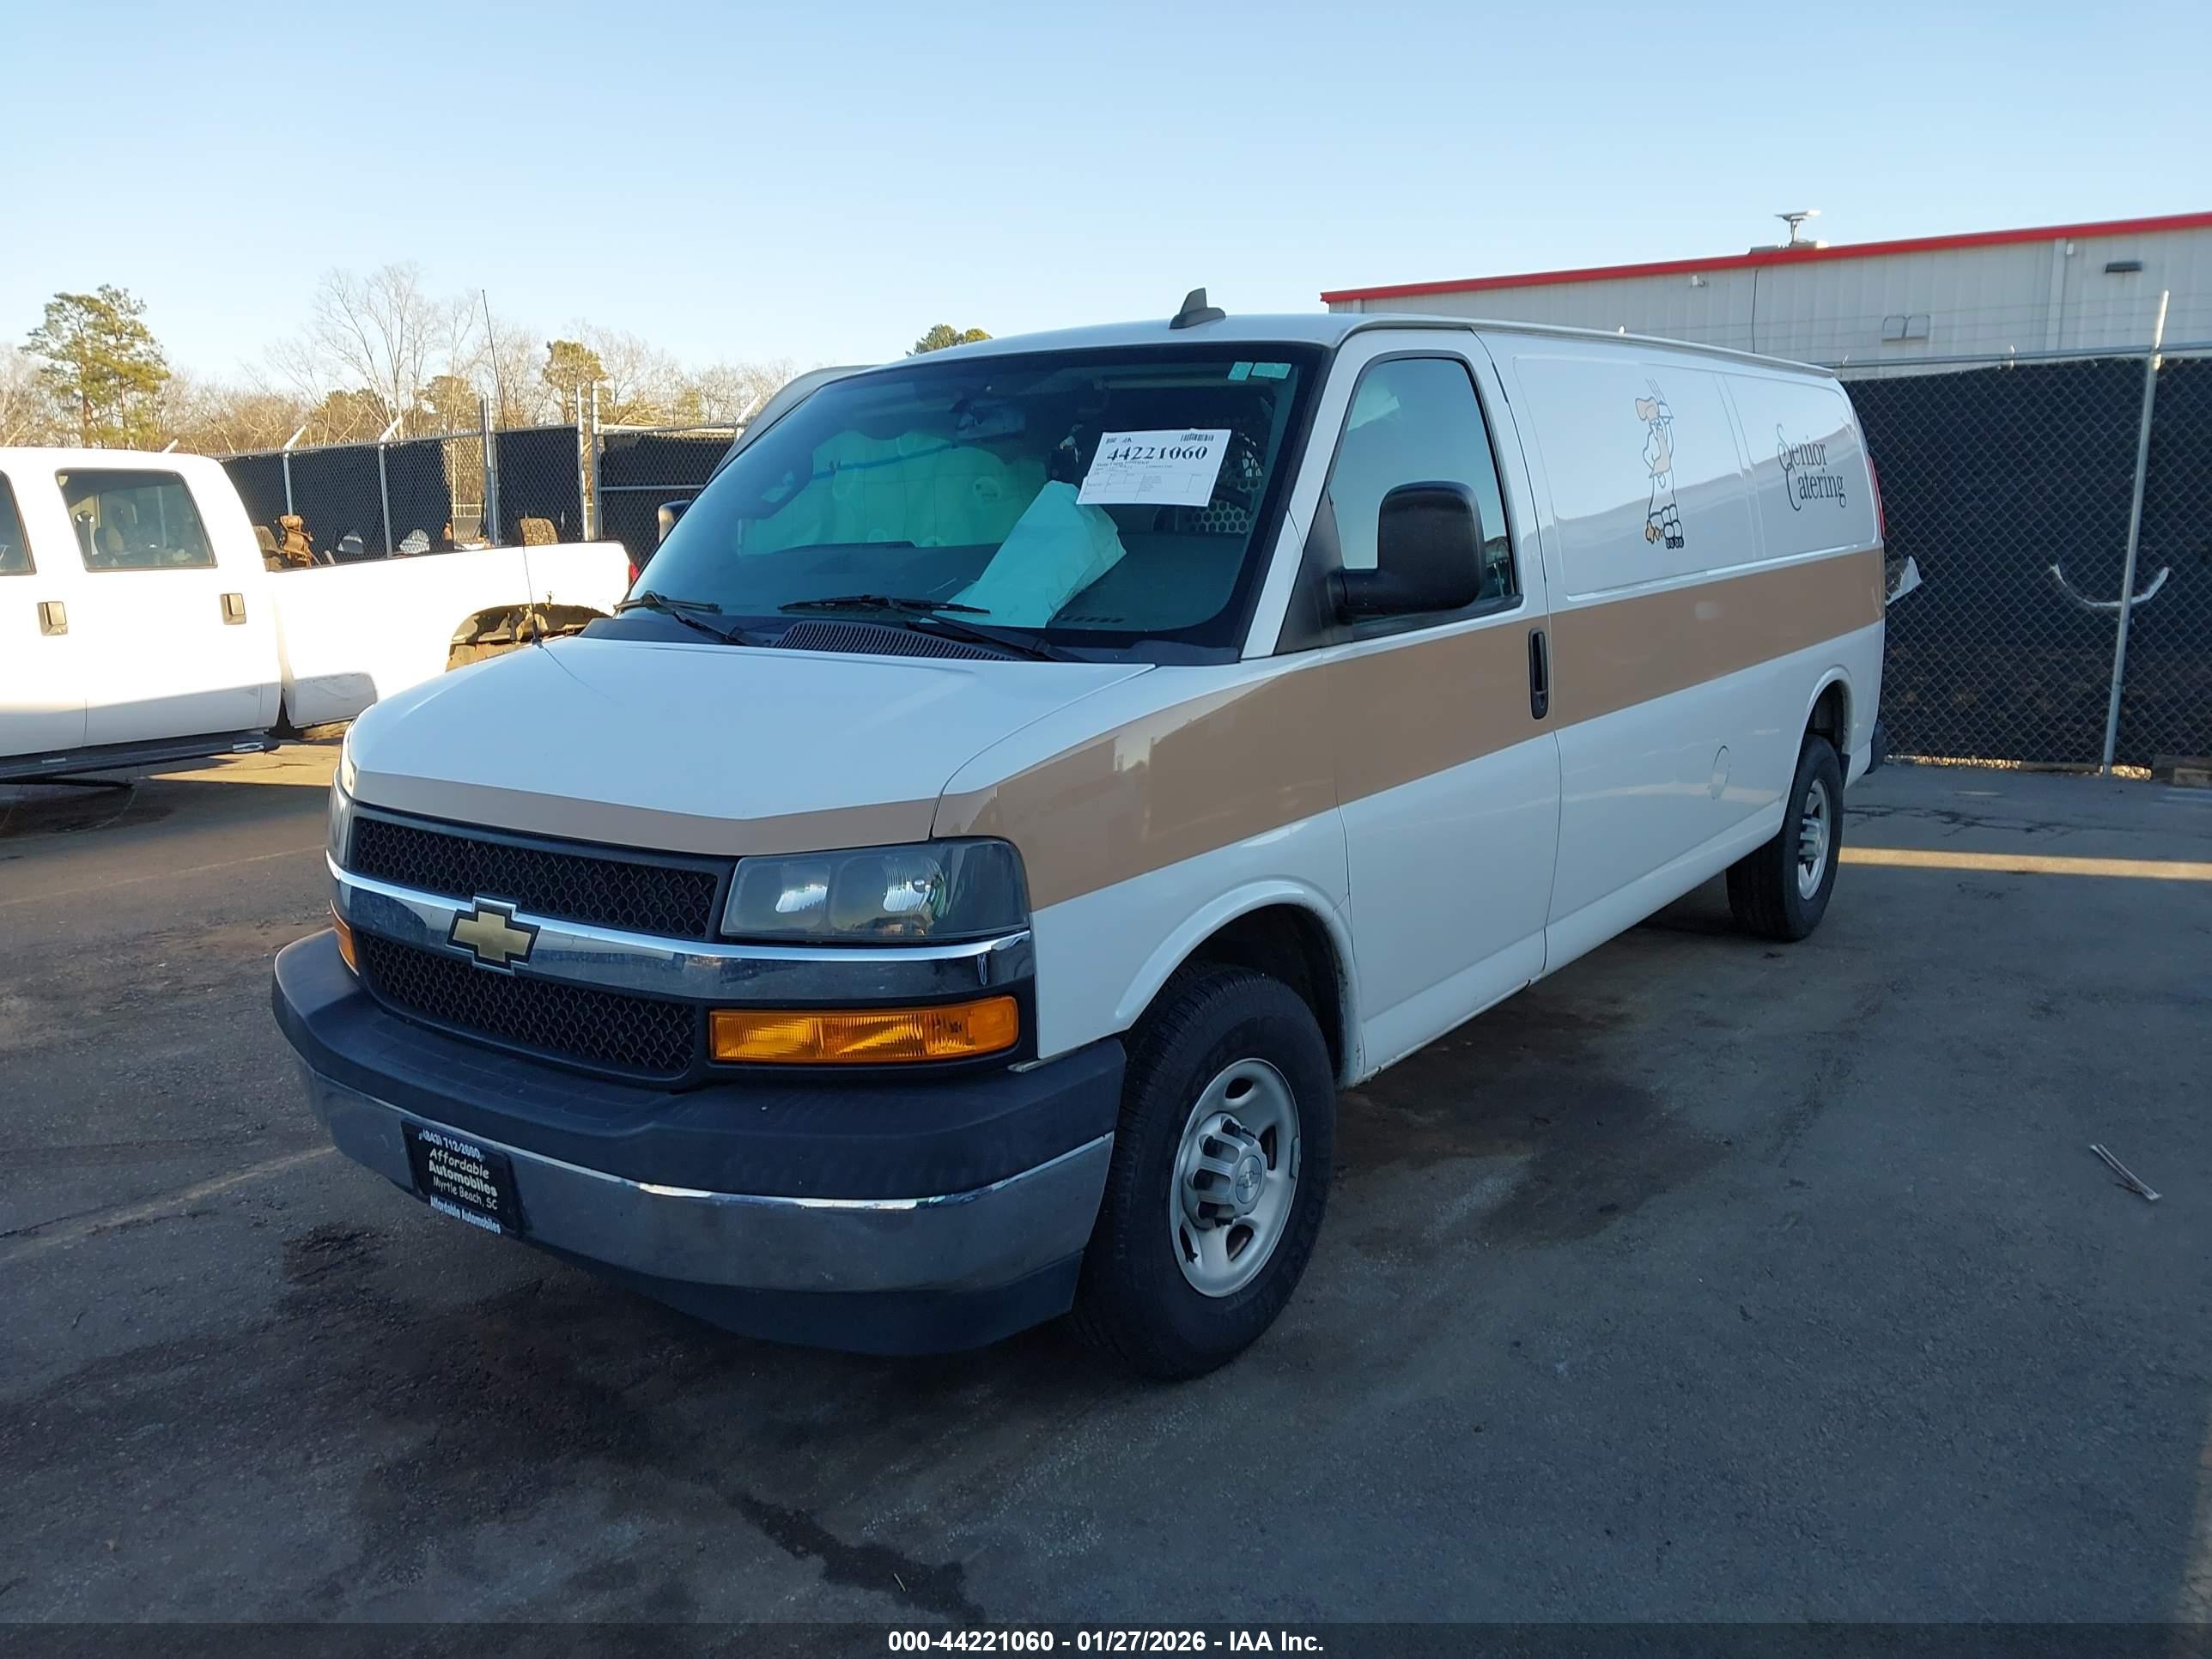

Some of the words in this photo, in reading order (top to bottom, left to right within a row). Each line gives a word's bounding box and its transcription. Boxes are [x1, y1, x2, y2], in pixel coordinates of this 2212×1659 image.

[1107, 446, 1208, 461] 44221060
[1777, 423, 1827, 471] Senior
[1786, 463, 1847, 511] Catering
[428, 1159, 498, 1197] Automobiles
[429, 1148, 490, 1179] Affordable
[433, 1176, 458, 1194] Myrtle
[459, 1186, 484, 1207] Beach,
[486, 1197, 498, 1210] SC
[429, 1195, 461, 1219] Affordable
[461, 1208, 501, 1234] Automobiles
